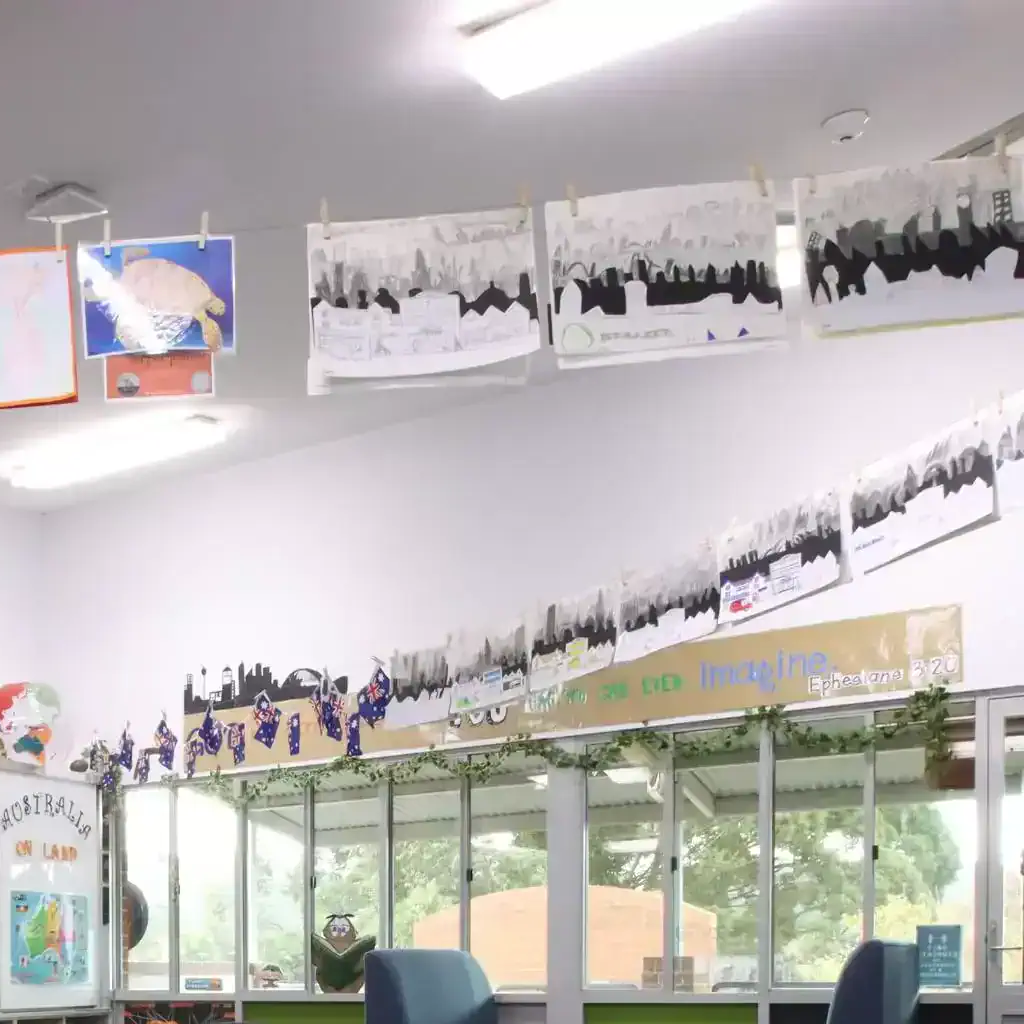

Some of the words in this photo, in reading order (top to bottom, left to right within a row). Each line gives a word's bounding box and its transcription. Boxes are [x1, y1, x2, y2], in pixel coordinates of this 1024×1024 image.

[808, 668, 904, 696] Ephesians
[911, 655, 959, 679] 3:20
[0, 792, 92, 840] AUSTRALIA
[16, 840, 32, 857] ON
[42, 842, 78, 861] LAND
